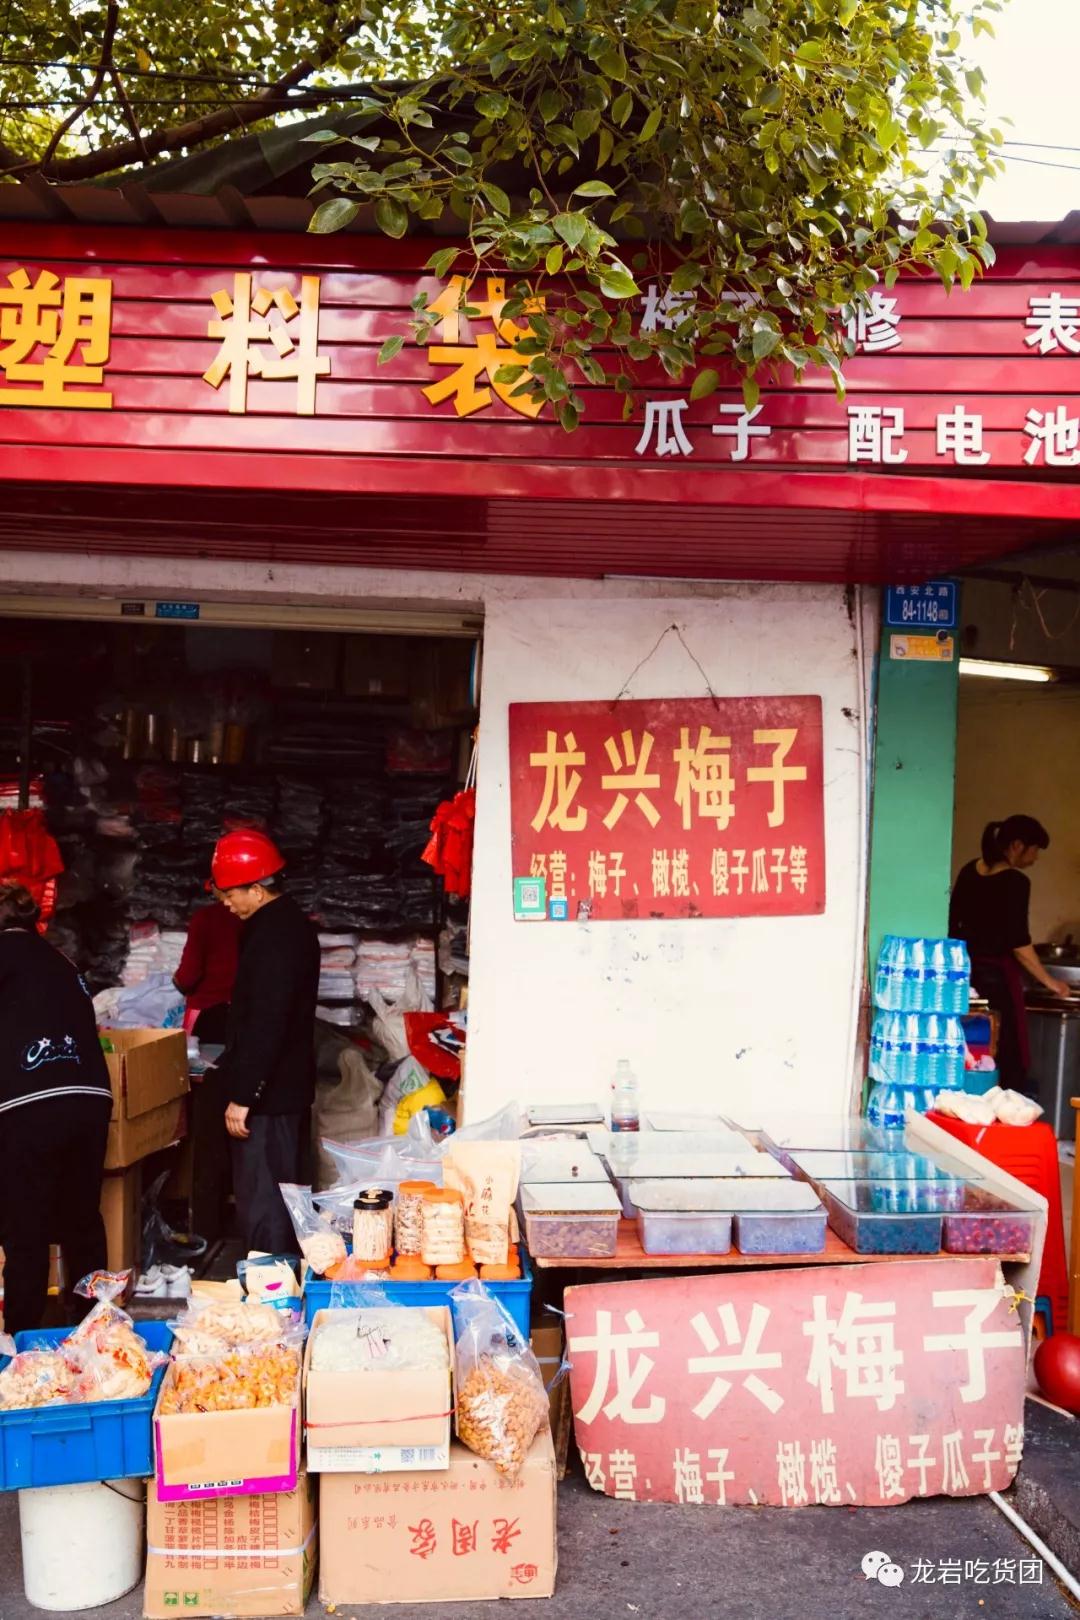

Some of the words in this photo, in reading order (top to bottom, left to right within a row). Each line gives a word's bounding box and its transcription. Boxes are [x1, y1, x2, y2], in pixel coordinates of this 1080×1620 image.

[0, 268, 547, 419] 塑料袋
[841, 291, 1080, 355] 修表
[634, 398, 772, 462] 瓜子
[847, 405, 1080, 467] 配电池
[529, 725, 808, 833] 龙兴梅子
[569, 1288, 1023, 1425] 龙兴梅子
[408, 1517, 522, 1560] 老周家
